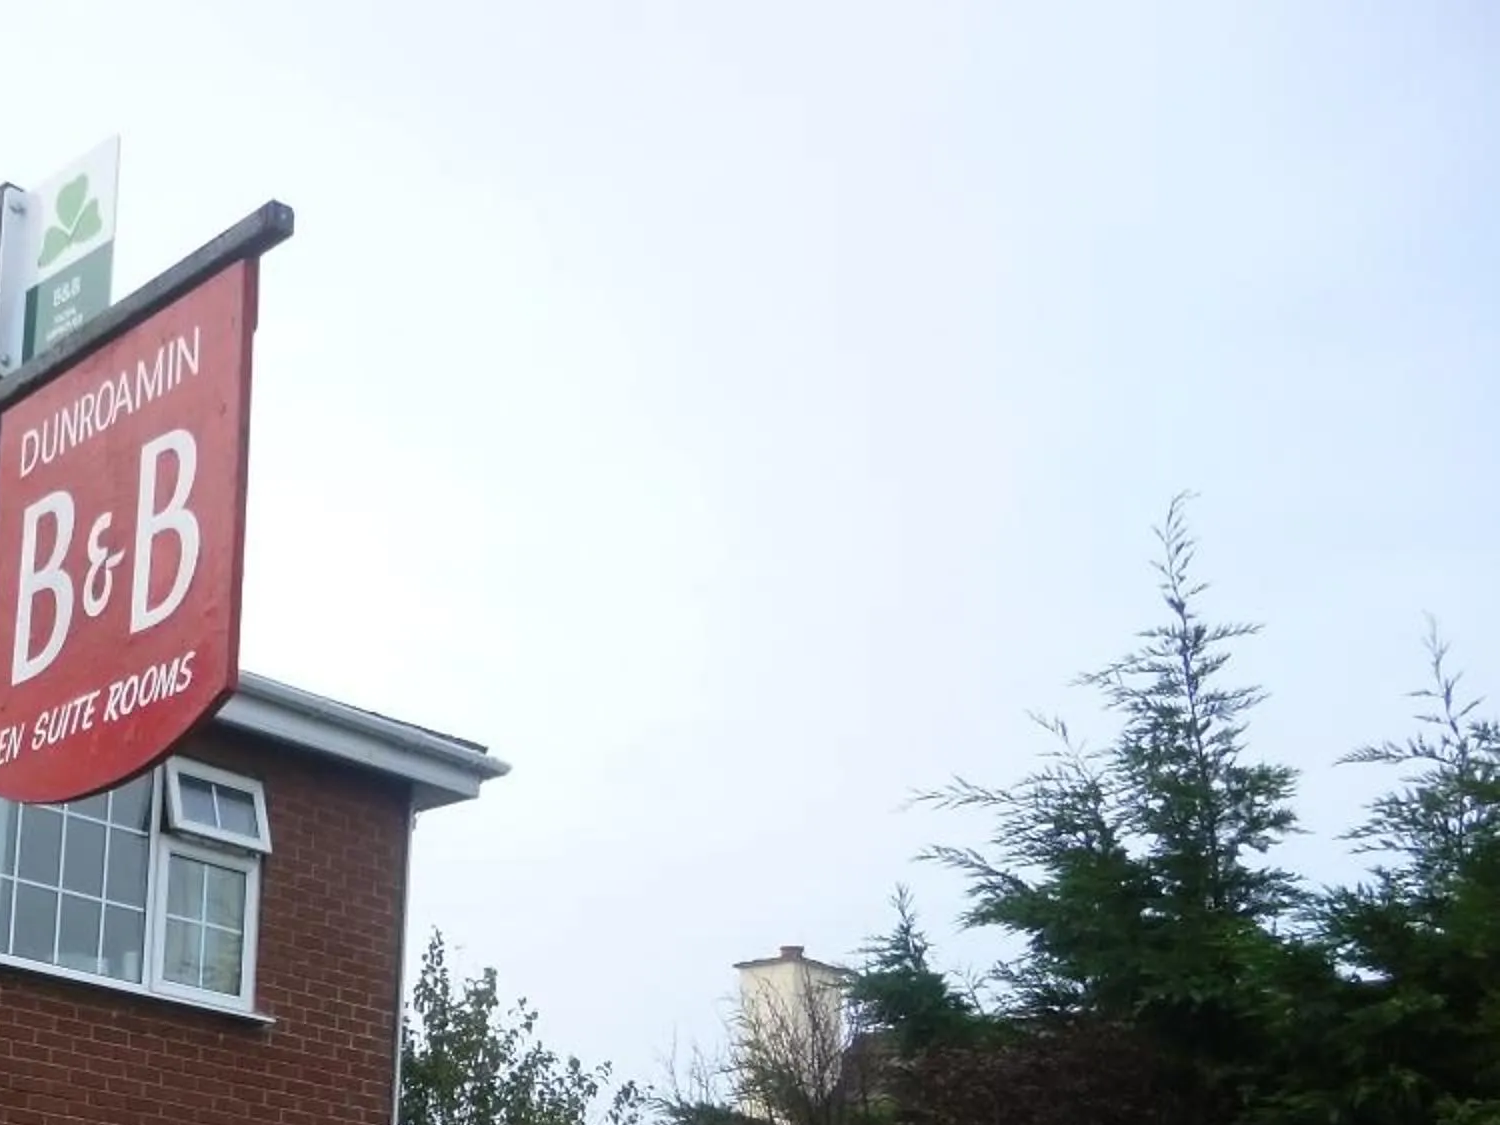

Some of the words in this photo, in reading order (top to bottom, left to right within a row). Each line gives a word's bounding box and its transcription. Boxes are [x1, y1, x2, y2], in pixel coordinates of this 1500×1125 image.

[20, 325, 200, 478] DUNROAMIN
[31, 690, 101, 750] SUITE
[103, 650, 197, 722] ROOMS
